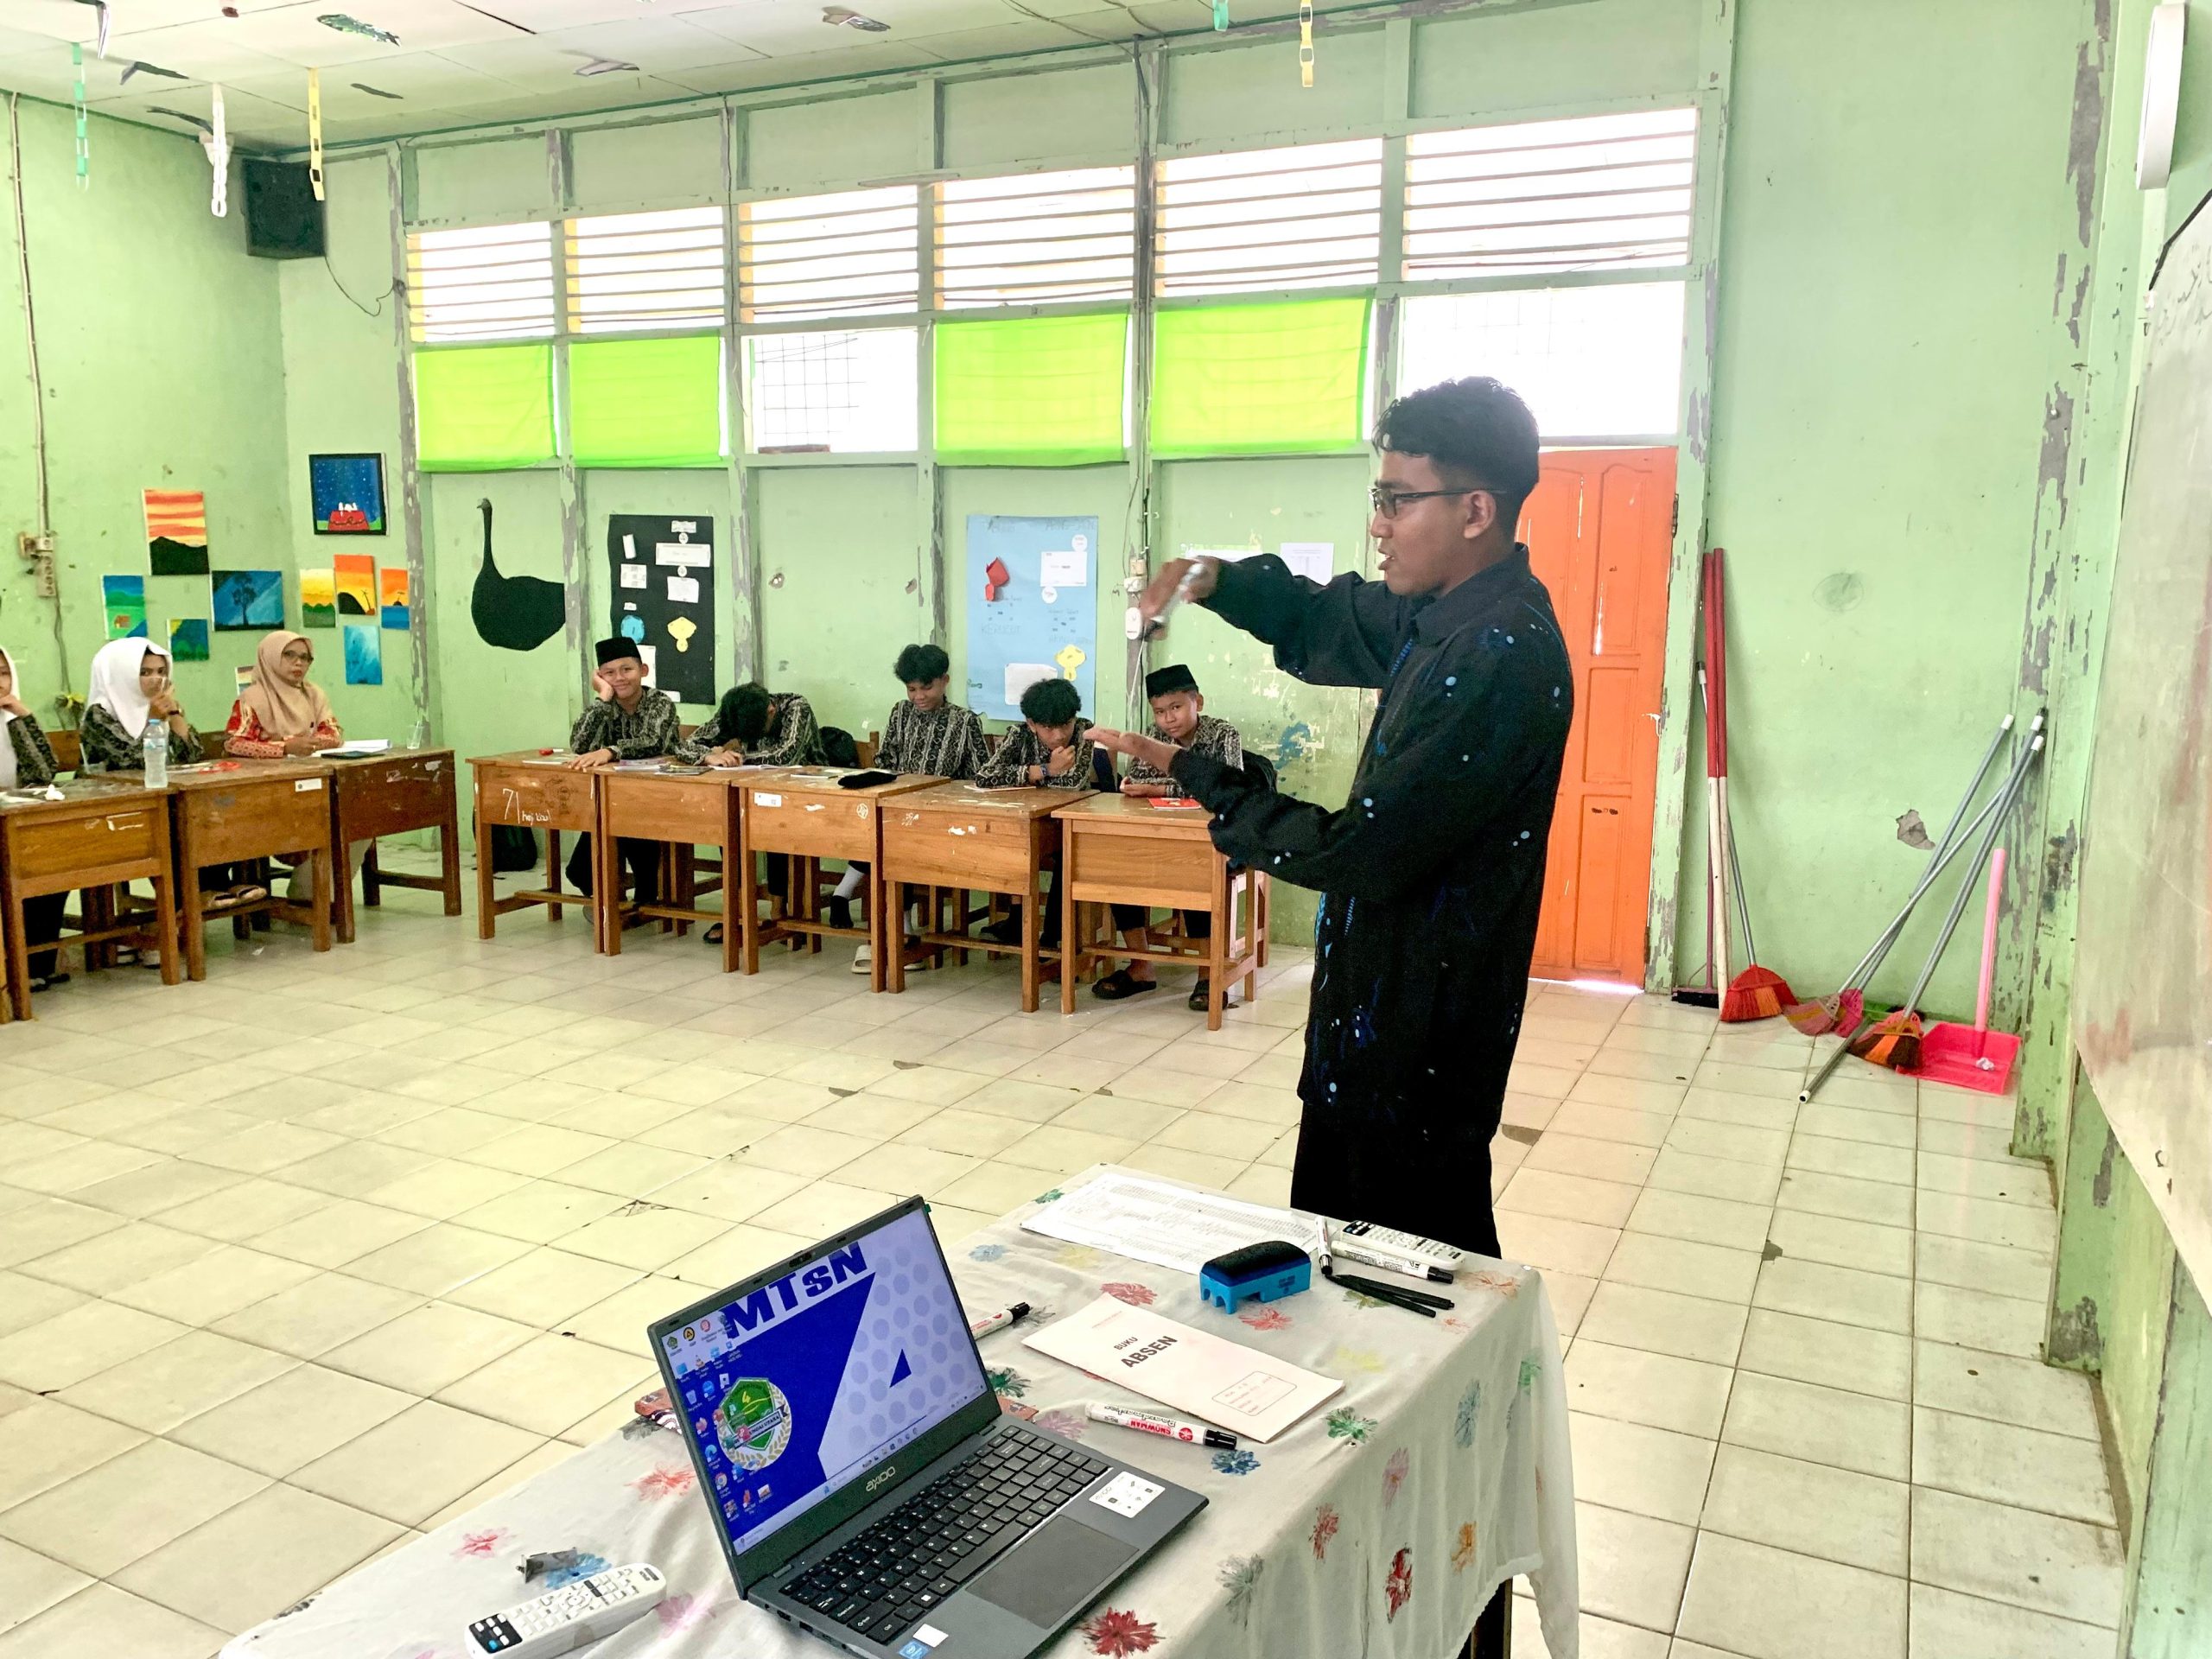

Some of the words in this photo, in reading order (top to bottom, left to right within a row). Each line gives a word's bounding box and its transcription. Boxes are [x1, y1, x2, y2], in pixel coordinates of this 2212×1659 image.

[1113, 1336, 1139, 1351] BUKU
[1121, 1335, 1178, 1368] ABSEN
[1130, 1420, 1172, 1435] SNOWMAN
